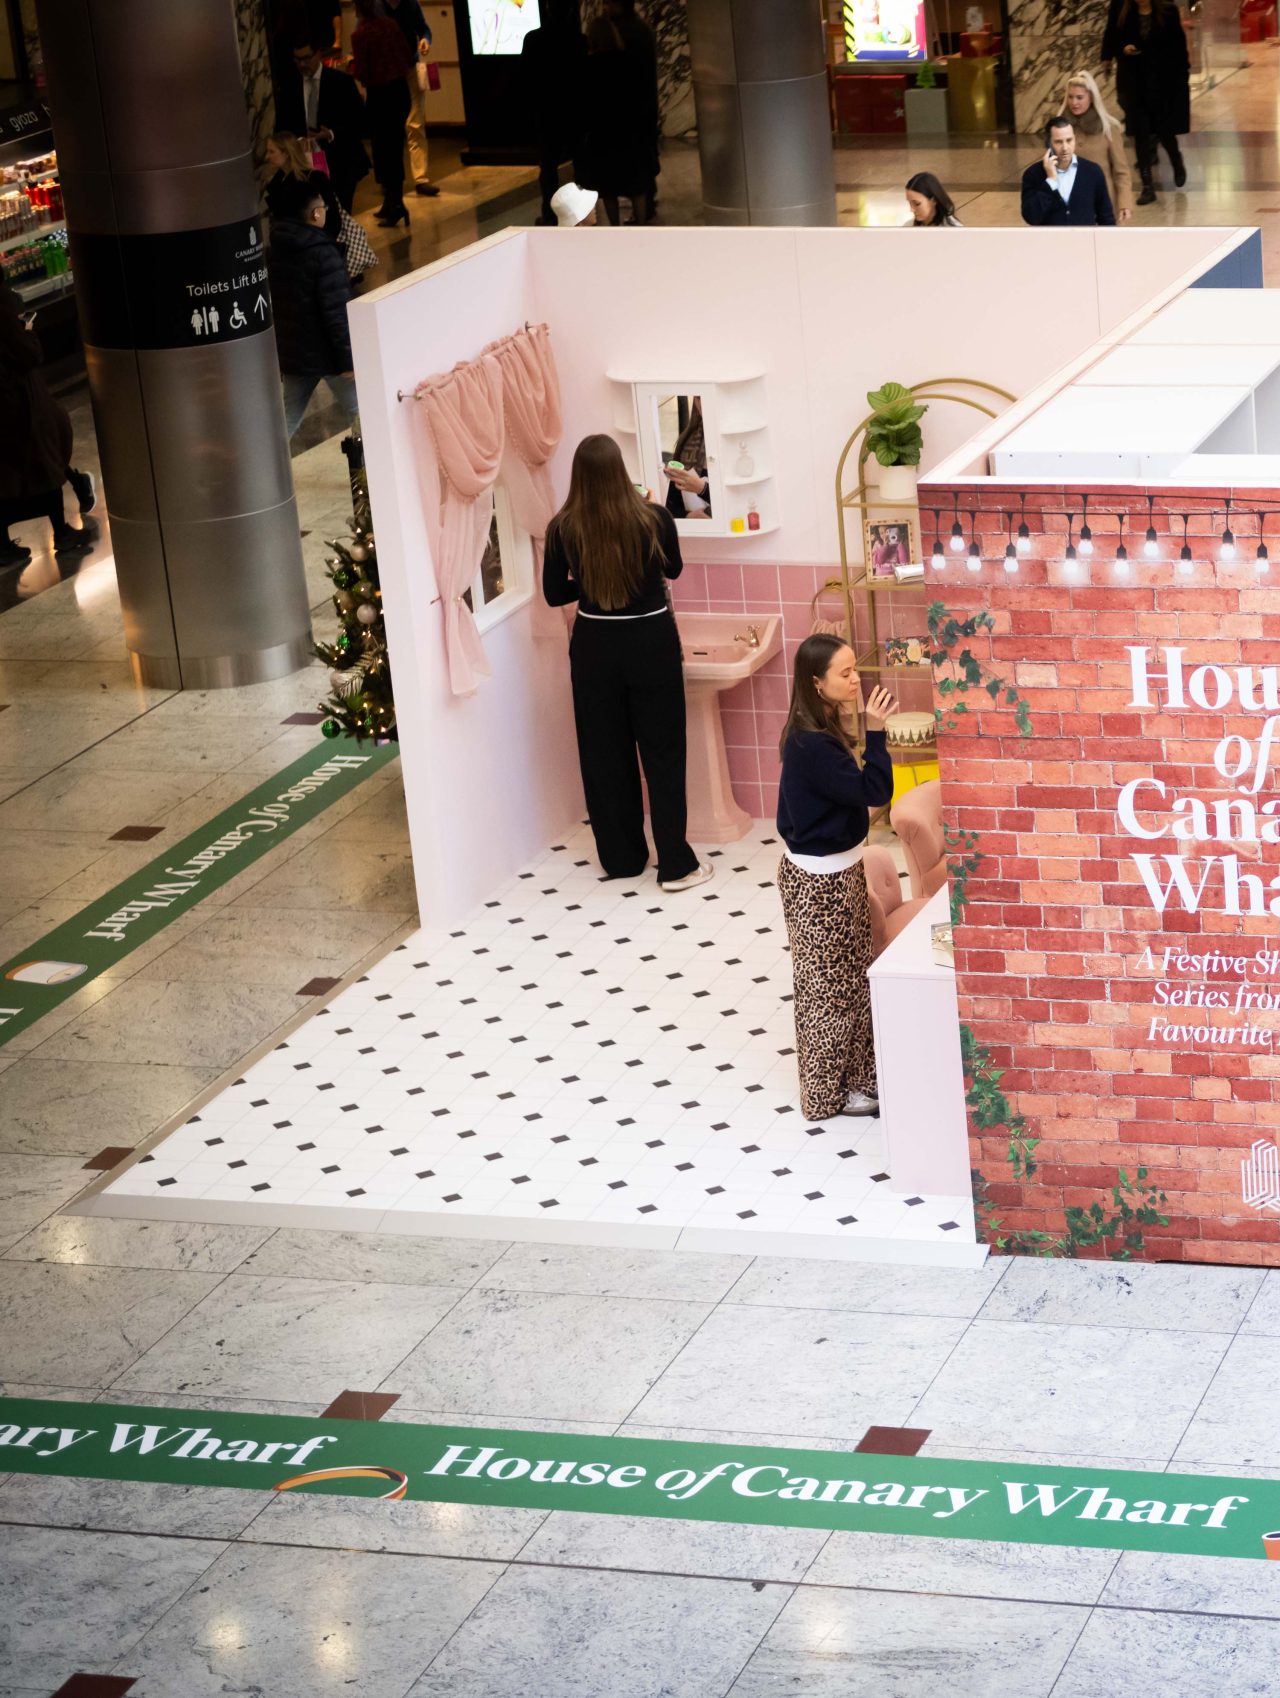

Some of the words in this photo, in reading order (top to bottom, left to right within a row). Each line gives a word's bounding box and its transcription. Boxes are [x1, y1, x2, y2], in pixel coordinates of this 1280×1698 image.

[186, 281, 230, 297] Toilets
[232, 274, 250, 290] Lift
[251, 272, 258, 284] &
[277, 754, 373, 803] House
[249, 803, 291, 823] of
[165, 819, 278, 878] Canary
[82, 879, 200, 942] Wharf
[1135, 946, 1155, 970] A
[1160, 946, 1248, 975] Festive
[1152, 981, 1230, 1009] Series
[1146, 1015, 1273, 1046] Favourite
[108, 1422, 338, 1466] Wharf
[424, 1445, 647, 1489] House
[654, 1462, 745, 1501] of
[731, 1464, 990, 1520] Canary
[1002, 1480, 1251, 1529] Wharf
